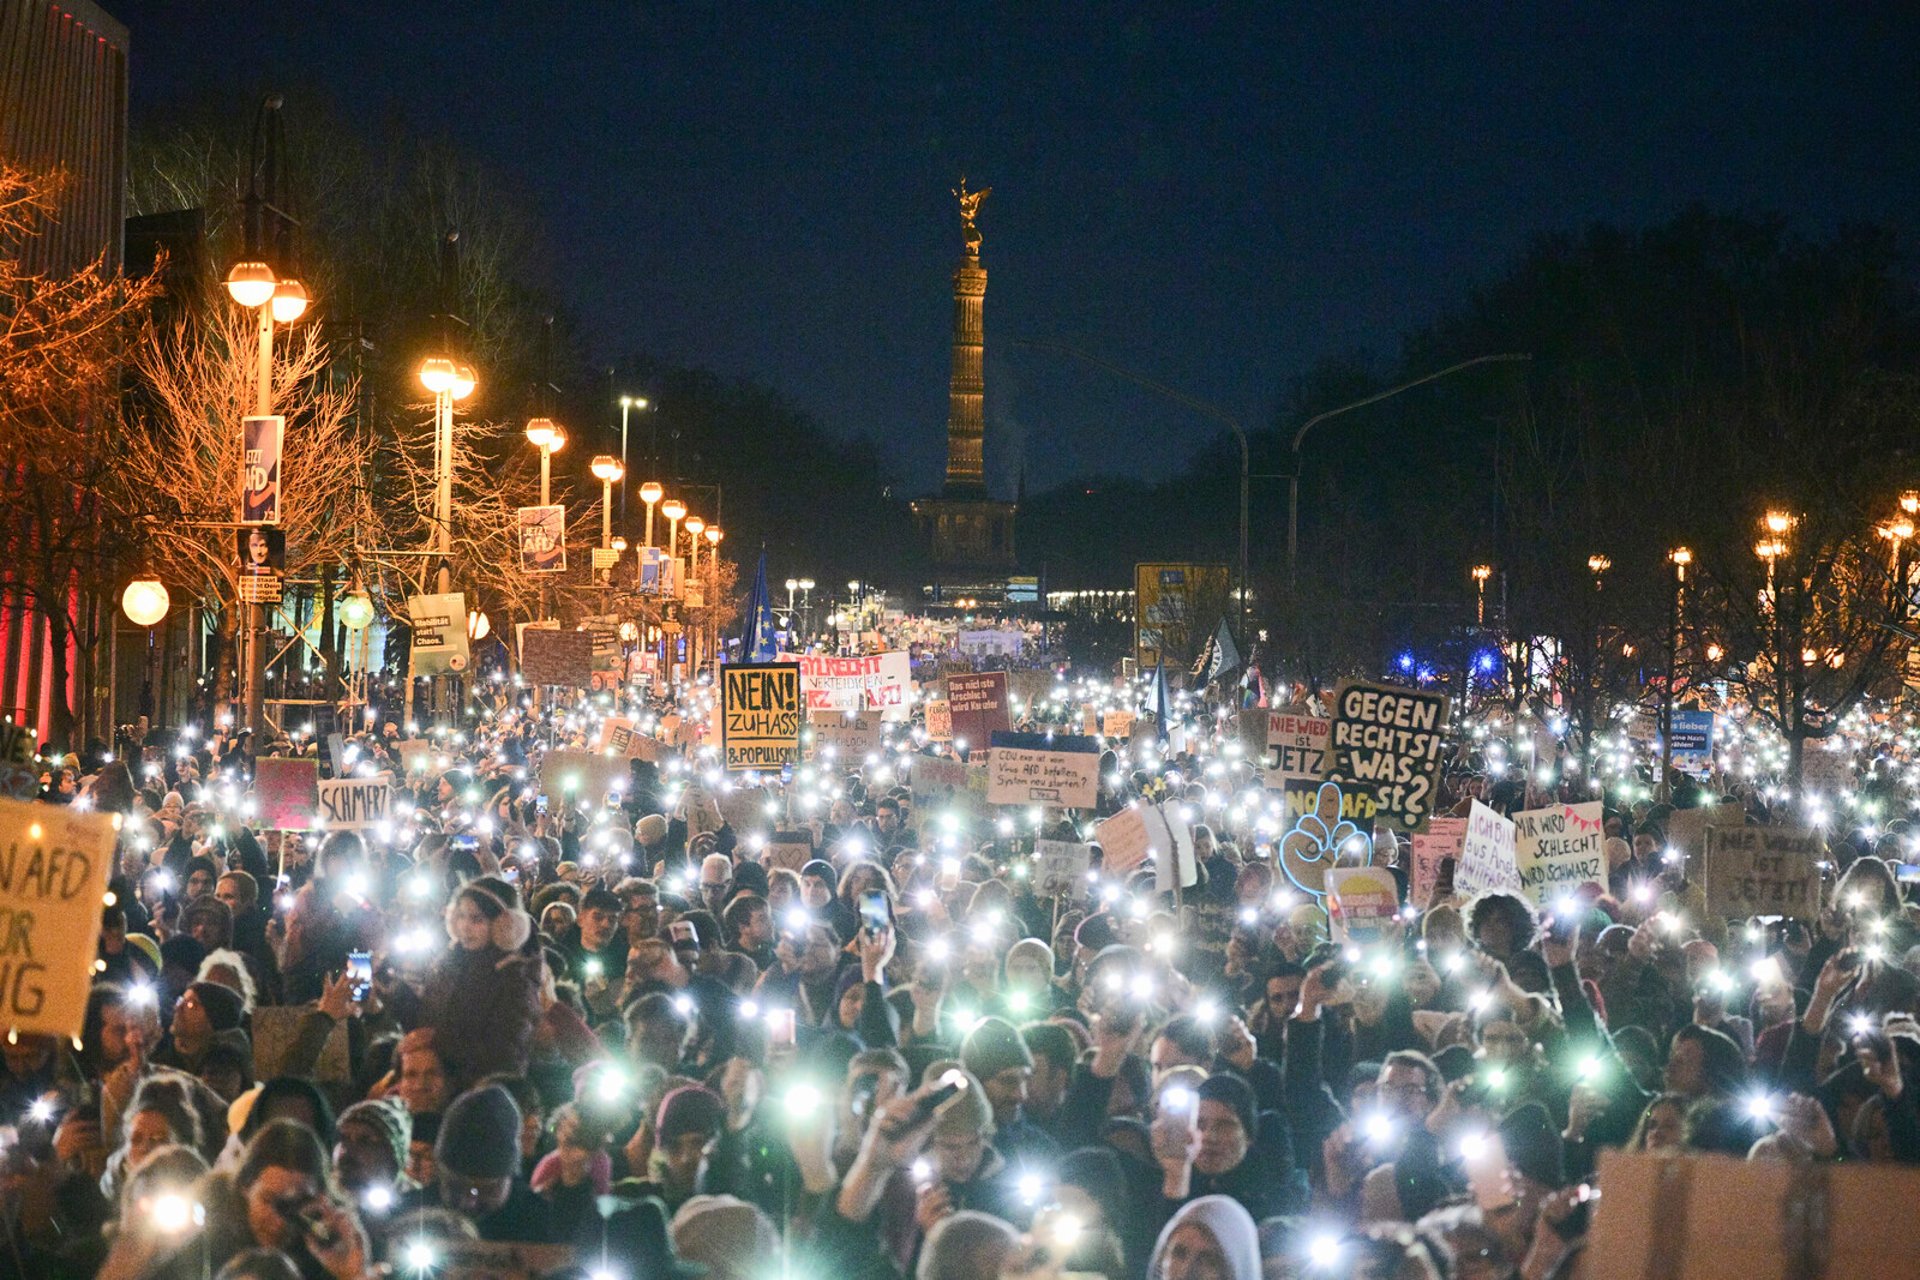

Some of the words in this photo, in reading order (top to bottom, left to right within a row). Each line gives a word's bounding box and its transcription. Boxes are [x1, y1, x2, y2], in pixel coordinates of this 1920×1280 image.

[246, 450, 263, 465] ETZT
[414, 617, 449, 627] Stabilität
[416, 637, 442, 646] Chaos.
[728, 672, 796, 711] NEIN!
[1345, 691, 1438, 730] GEGEN
[1296, 735, 1310, 747] ist
[1336, 721, 1440, 772] RECHTS!
[1268, 744, 1324, 775] JETZ
[321, 784, 388, 822] SCHMERZ
[1284, 790, 1317, 818] NO
[1342, 794, 1377, 818] AFD
[1515, 816, 1538, 842] MIR
[1540, 814, 1566, 834] WIRD
[17, 847, 92, 901] AFD
[1546, 858, 1601, 882] SCHWARZ
